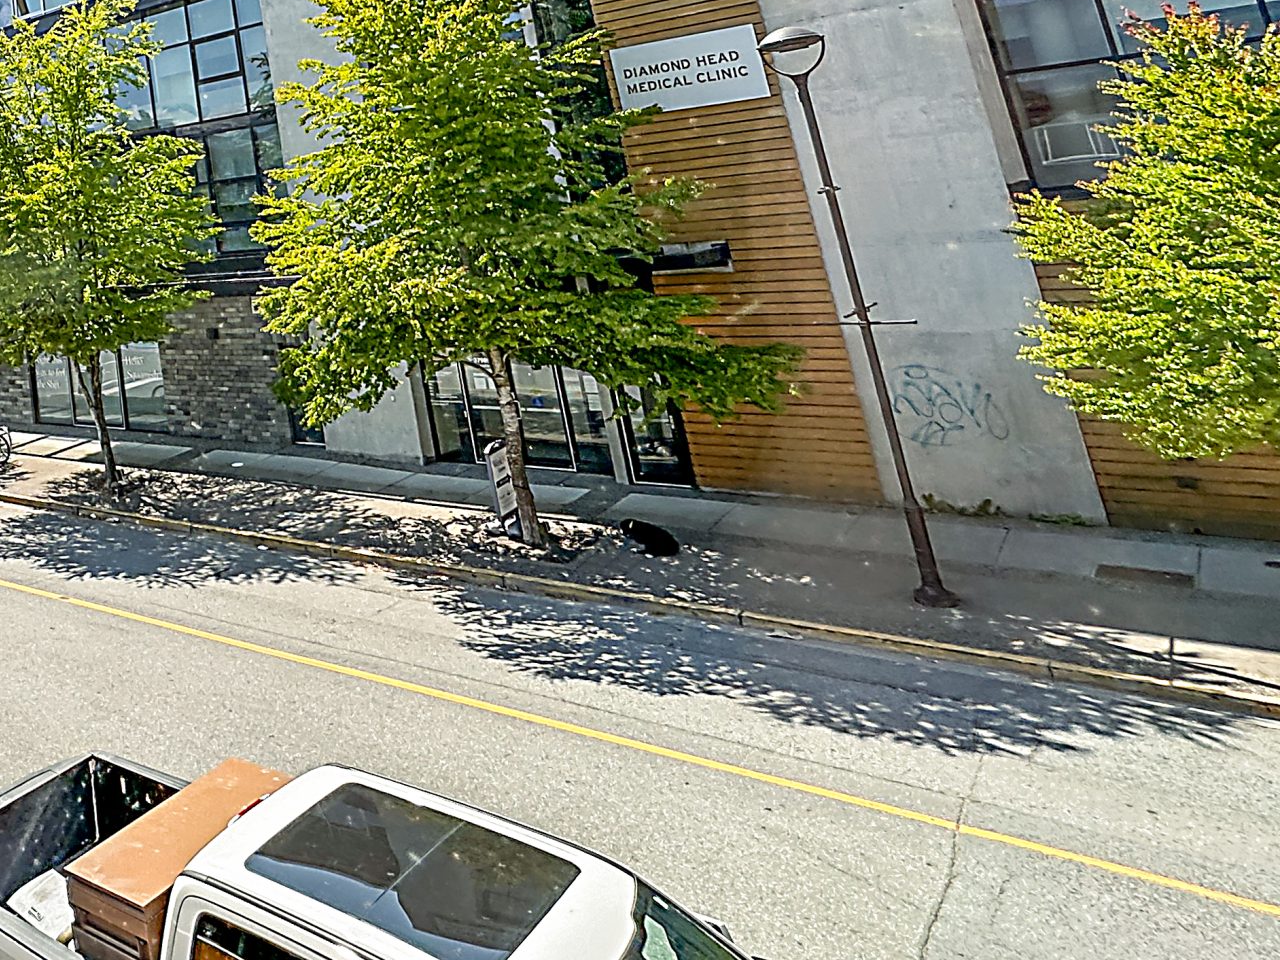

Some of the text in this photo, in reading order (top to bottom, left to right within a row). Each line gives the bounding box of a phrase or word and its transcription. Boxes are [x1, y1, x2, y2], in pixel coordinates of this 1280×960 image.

[623, 50, 739, 79] DIAMOND HEAD
[627, 65, 748, 94] MEDICAL CLINIC
